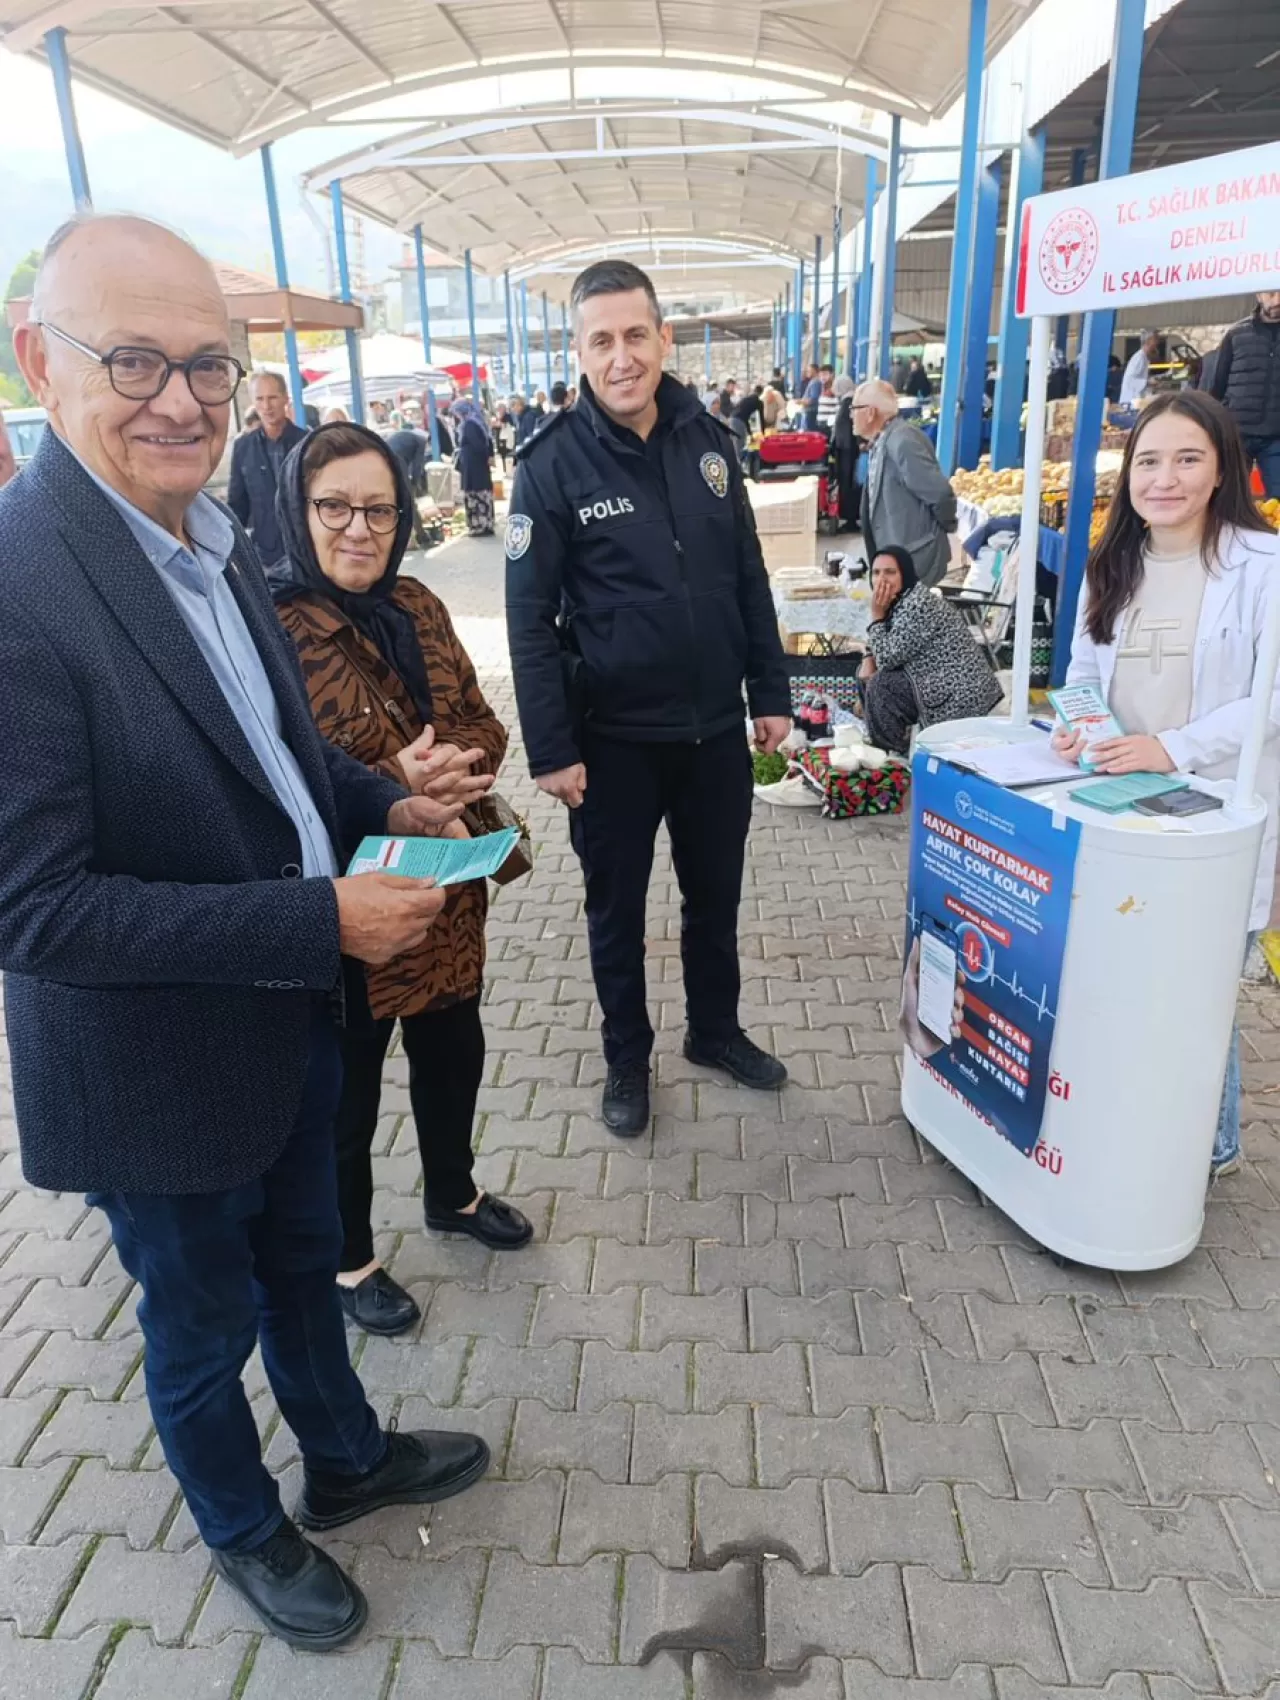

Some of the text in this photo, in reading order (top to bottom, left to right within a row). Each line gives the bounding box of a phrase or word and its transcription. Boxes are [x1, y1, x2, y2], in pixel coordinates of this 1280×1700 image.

[1116, 203, 1141, 225] T.C.
[1147, 185, 1209, 219] SAĞLIK
[1170, 215, 1247, 250] DENİZLİ
[1102, 271, 1116, 293] İL
[1120, 264, 1182, 290] SAĞLIK
[578, 496, 635, 525] POLİS
[922, 811, 962, 842] HAYAT
[963, 833, 1050, 892] KURTARMAK
[926, 834, 962, 864] ARTIK
[964, 855, 991, 880] ÇOK
[993, 869, 1041, 907] KOLAY
[988, 1012, 1031, 1053] ORGAN
[988, 1028, 1030, 1068] BAĞIŞI
[967, 1046, 1026, 1102] KURTARIR
[987, 1045, 1029, 1086] HAYAT
